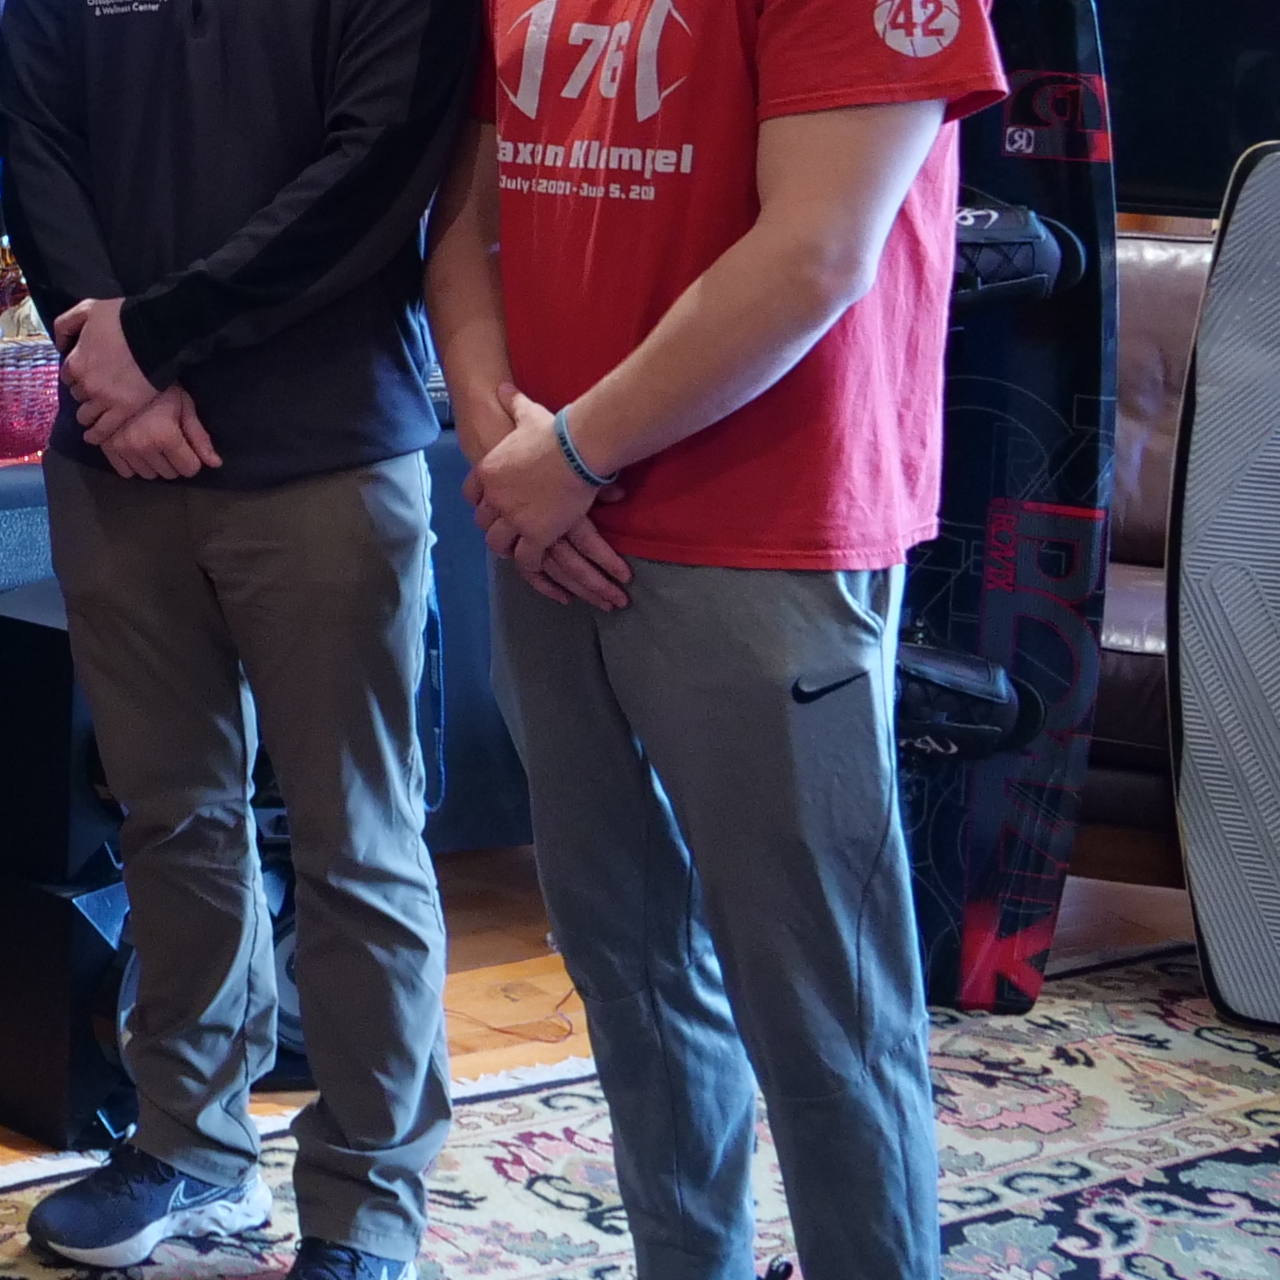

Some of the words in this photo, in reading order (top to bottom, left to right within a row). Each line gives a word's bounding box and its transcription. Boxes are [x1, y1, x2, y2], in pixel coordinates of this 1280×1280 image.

[102, 4, 131, 15] Wellness
[132, 2, 160, 12] Center
[560, 20, 632, 99] 76
[499, 174, 529, 194] July
